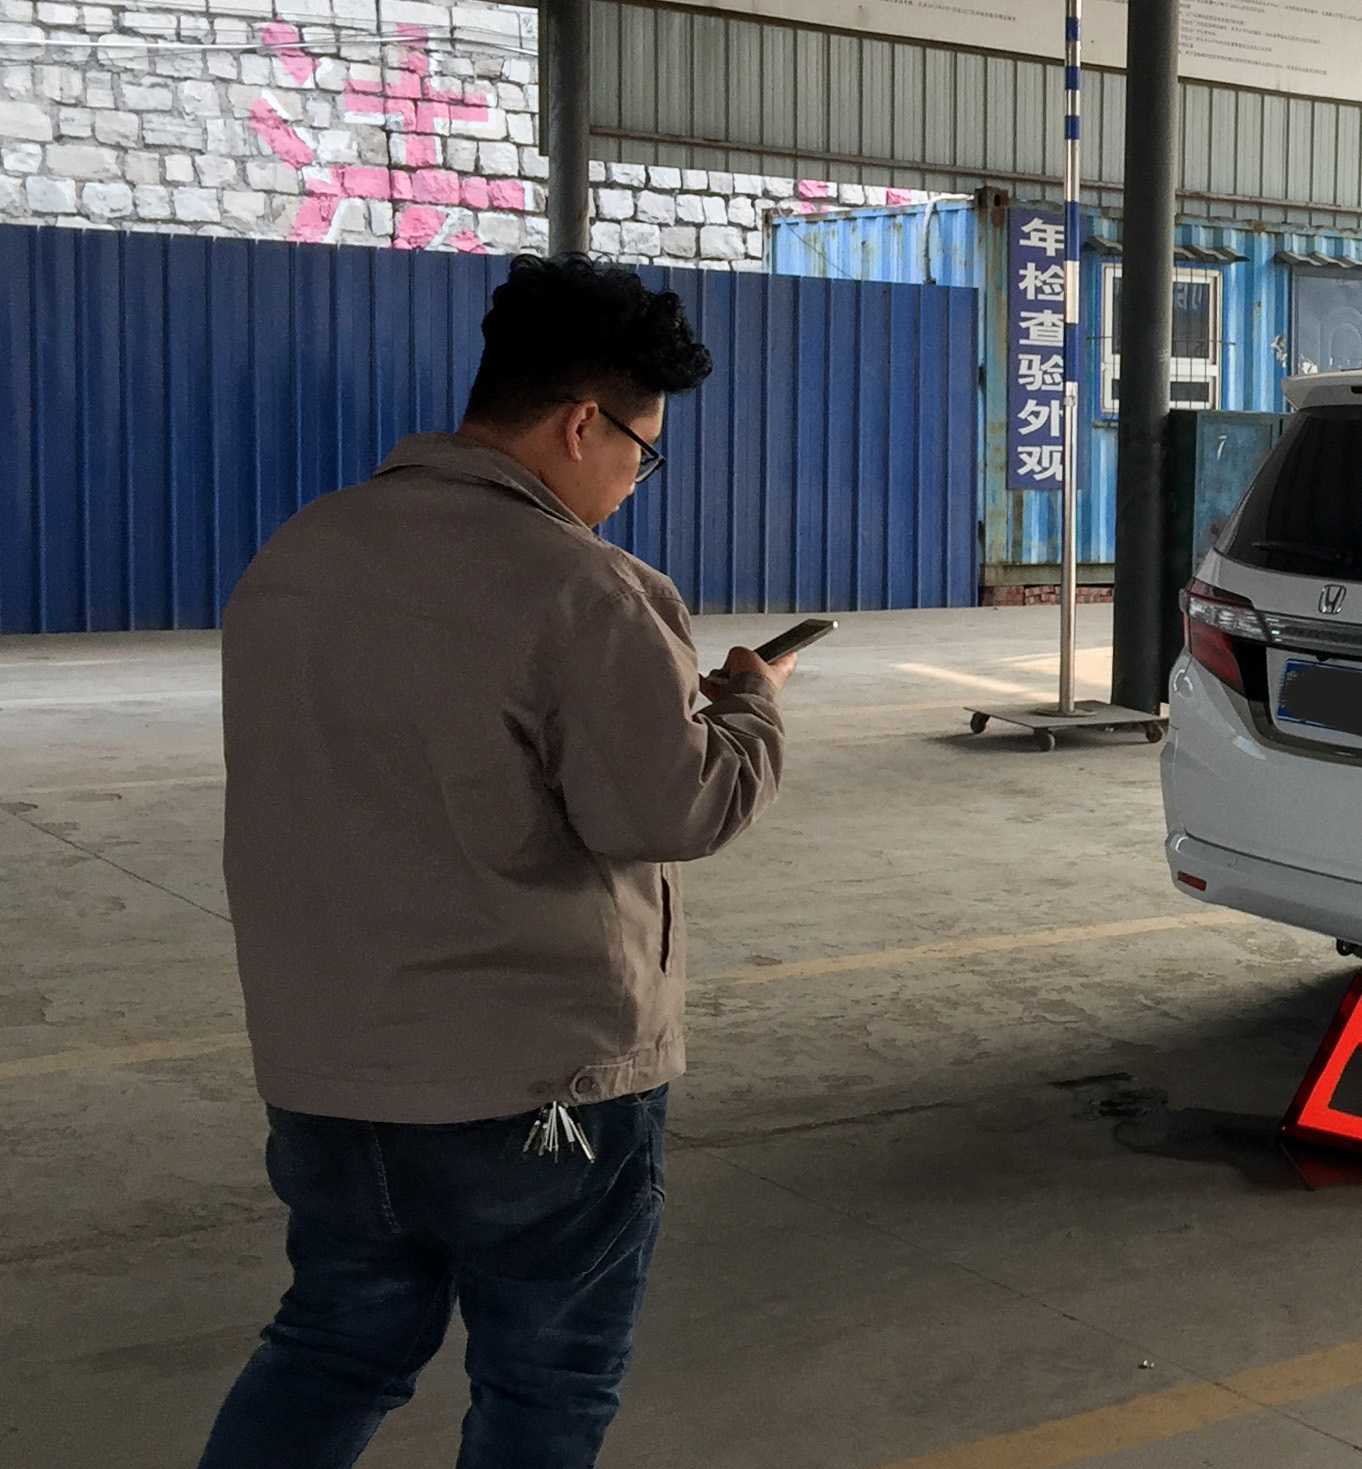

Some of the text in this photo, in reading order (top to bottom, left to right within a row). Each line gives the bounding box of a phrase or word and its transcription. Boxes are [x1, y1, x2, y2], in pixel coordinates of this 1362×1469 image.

[1017, 217, 1065, 482] 年检查验外观
